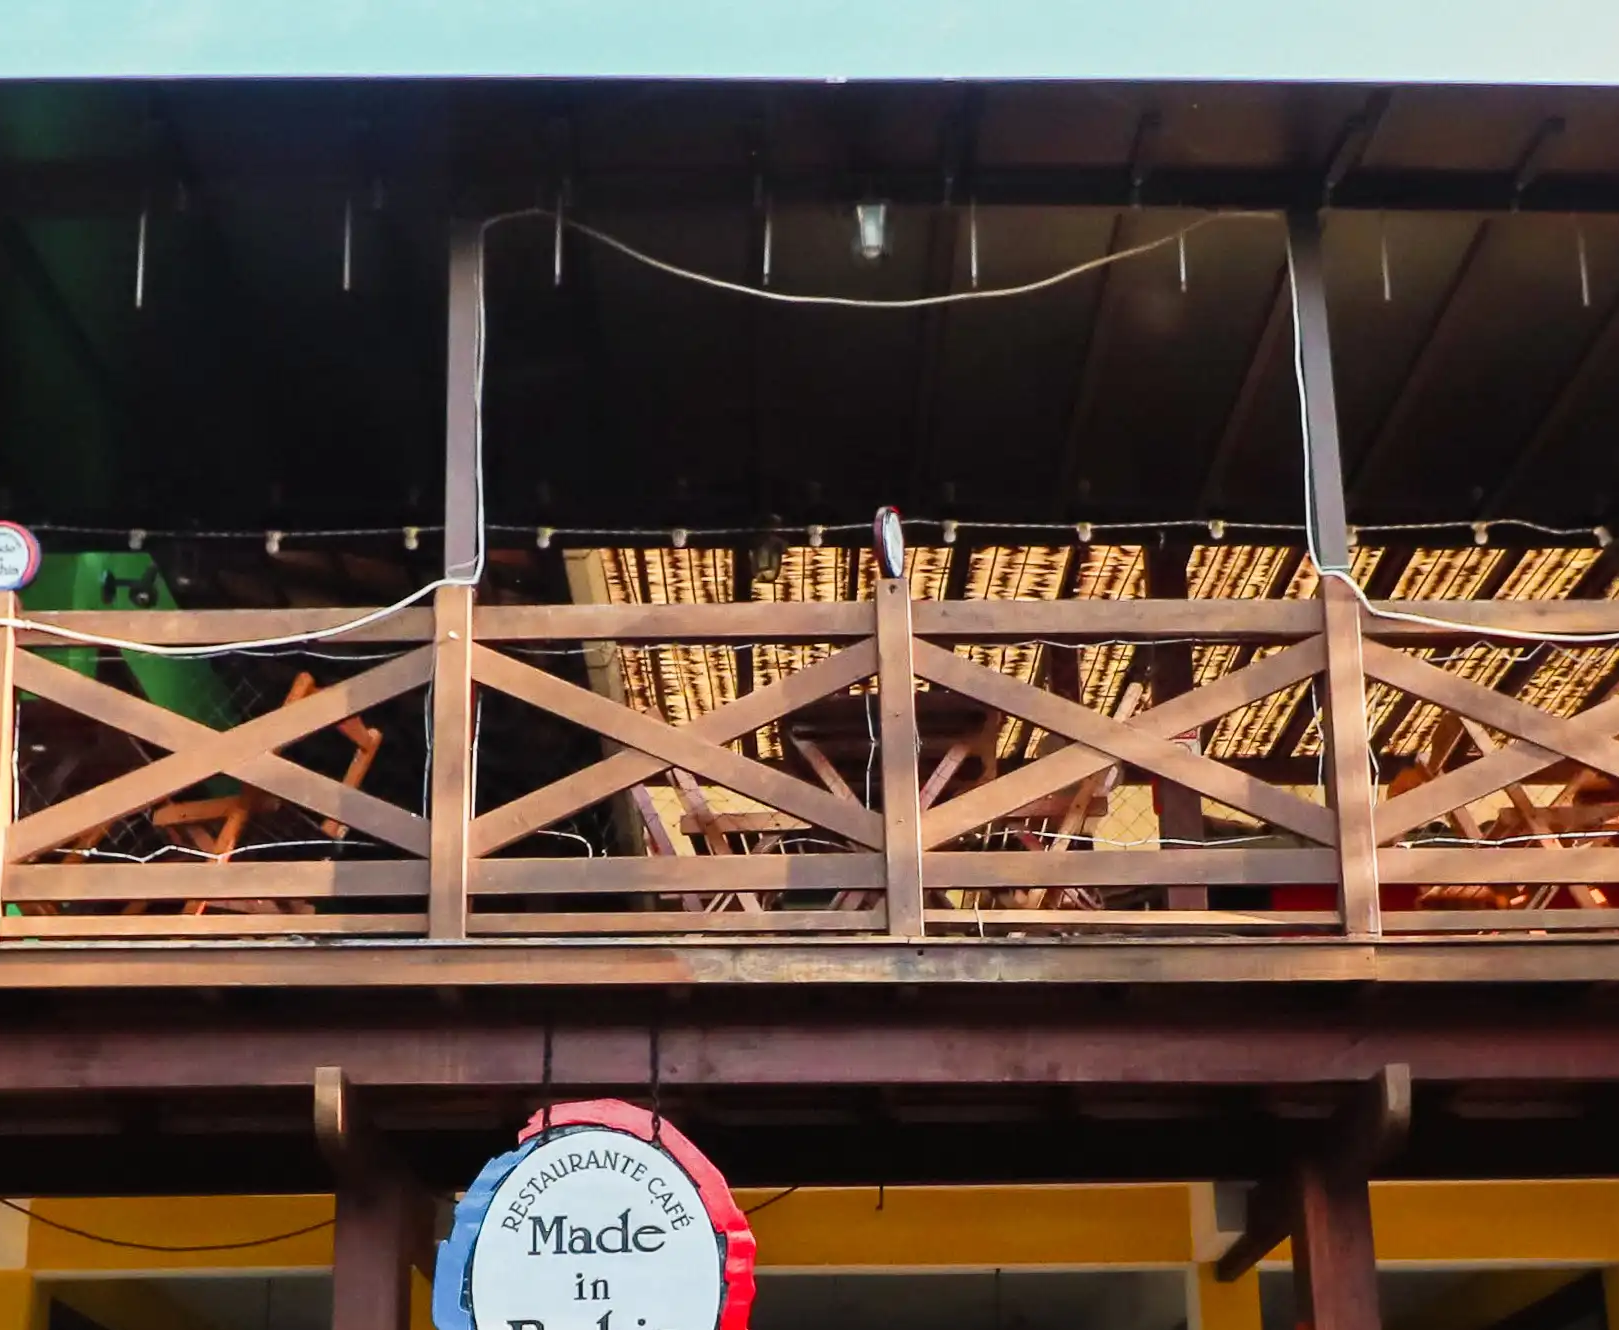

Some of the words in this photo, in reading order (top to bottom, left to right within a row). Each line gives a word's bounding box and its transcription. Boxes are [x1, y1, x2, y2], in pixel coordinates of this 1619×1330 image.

[501, 1149, 648, 1233] RESTAURANTE
[647, 1177, 695, 1231] CAFÉ
[527, 1207, 667, 1257] Made
[573, 1272, 611, 1301] in
